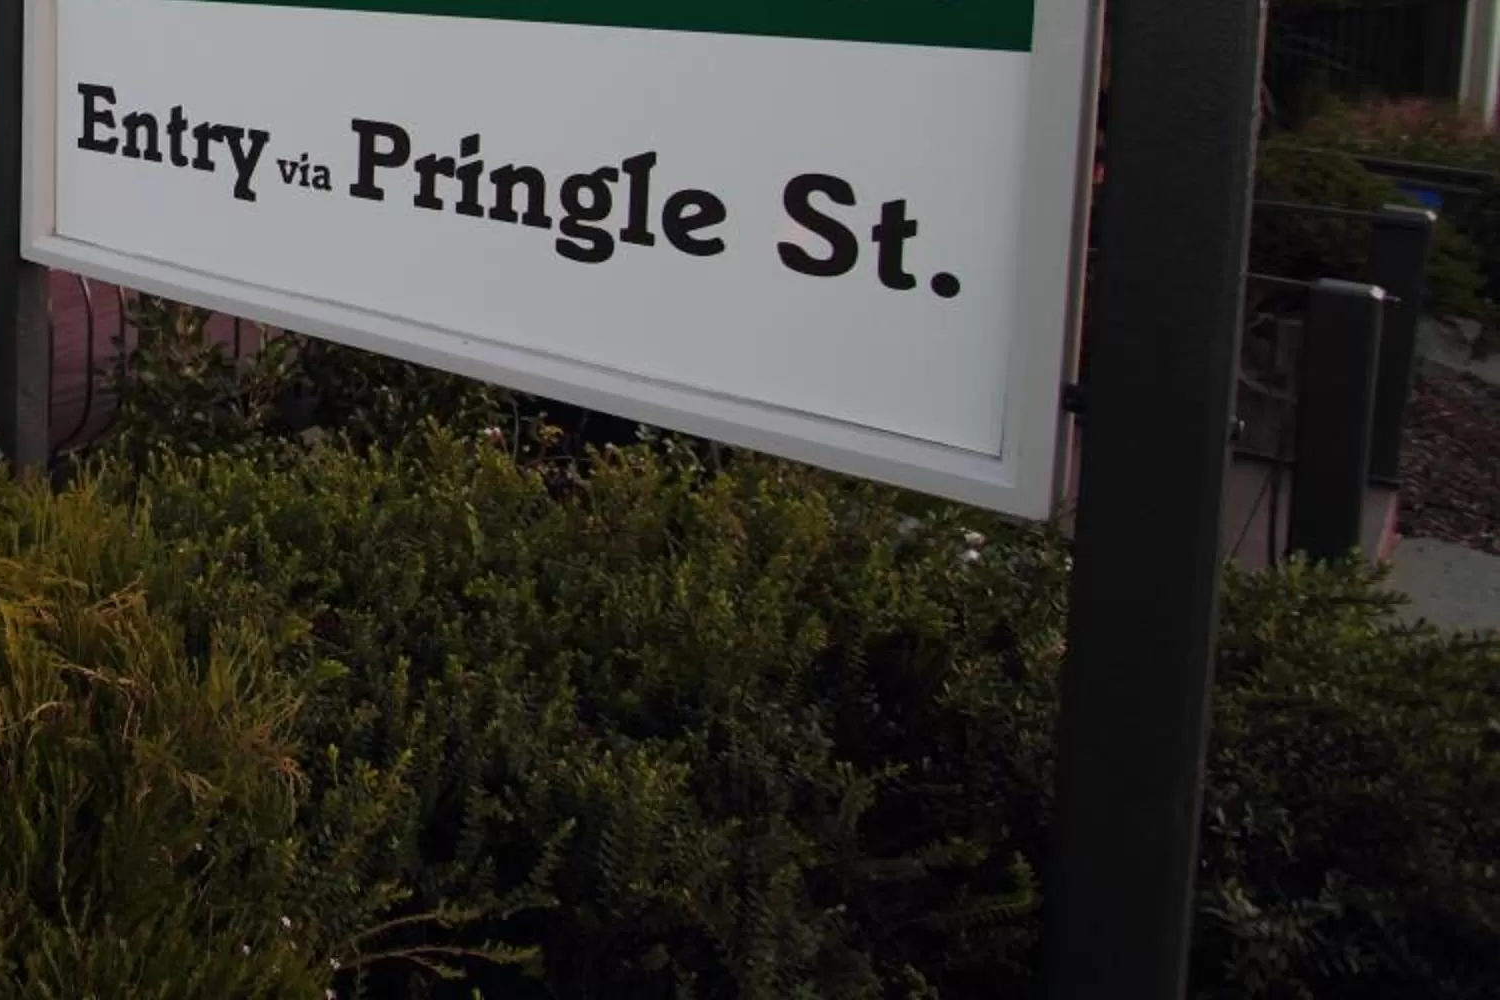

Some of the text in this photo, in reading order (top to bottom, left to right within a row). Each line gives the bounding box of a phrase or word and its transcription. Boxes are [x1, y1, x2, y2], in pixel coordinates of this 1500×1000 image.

[77, 82, 961, 299] Entry via Pringle St.
